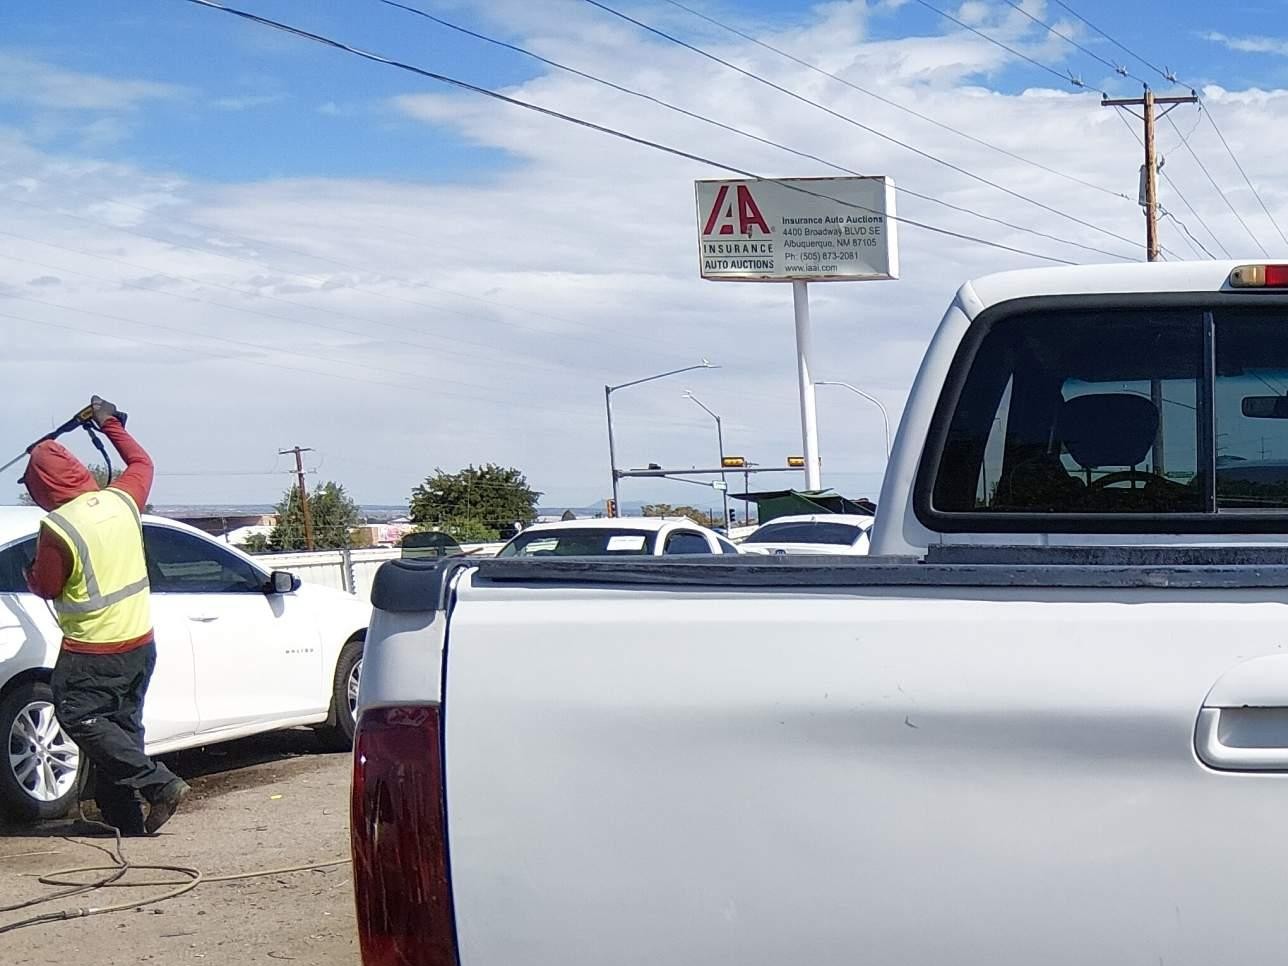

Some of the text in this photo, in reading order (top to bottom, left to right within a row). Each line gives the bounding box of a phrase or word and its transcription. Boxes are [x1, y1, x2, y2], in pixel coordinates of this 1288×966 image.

[782, 215, 883, 225] Insurance Auto Auctions
[783, 226, 881, 237] 4400 Broadway BLVD SE
[703, 243, 774, 254] INSURANCE
[783, 238, 877, 249] Albuquerque, NM 87105
[800, 252, 821, 262] (505)
[704, 259, 774, 270] AUTO AUCTIONS
[785, 264, 838, 272] www.iaai.com
